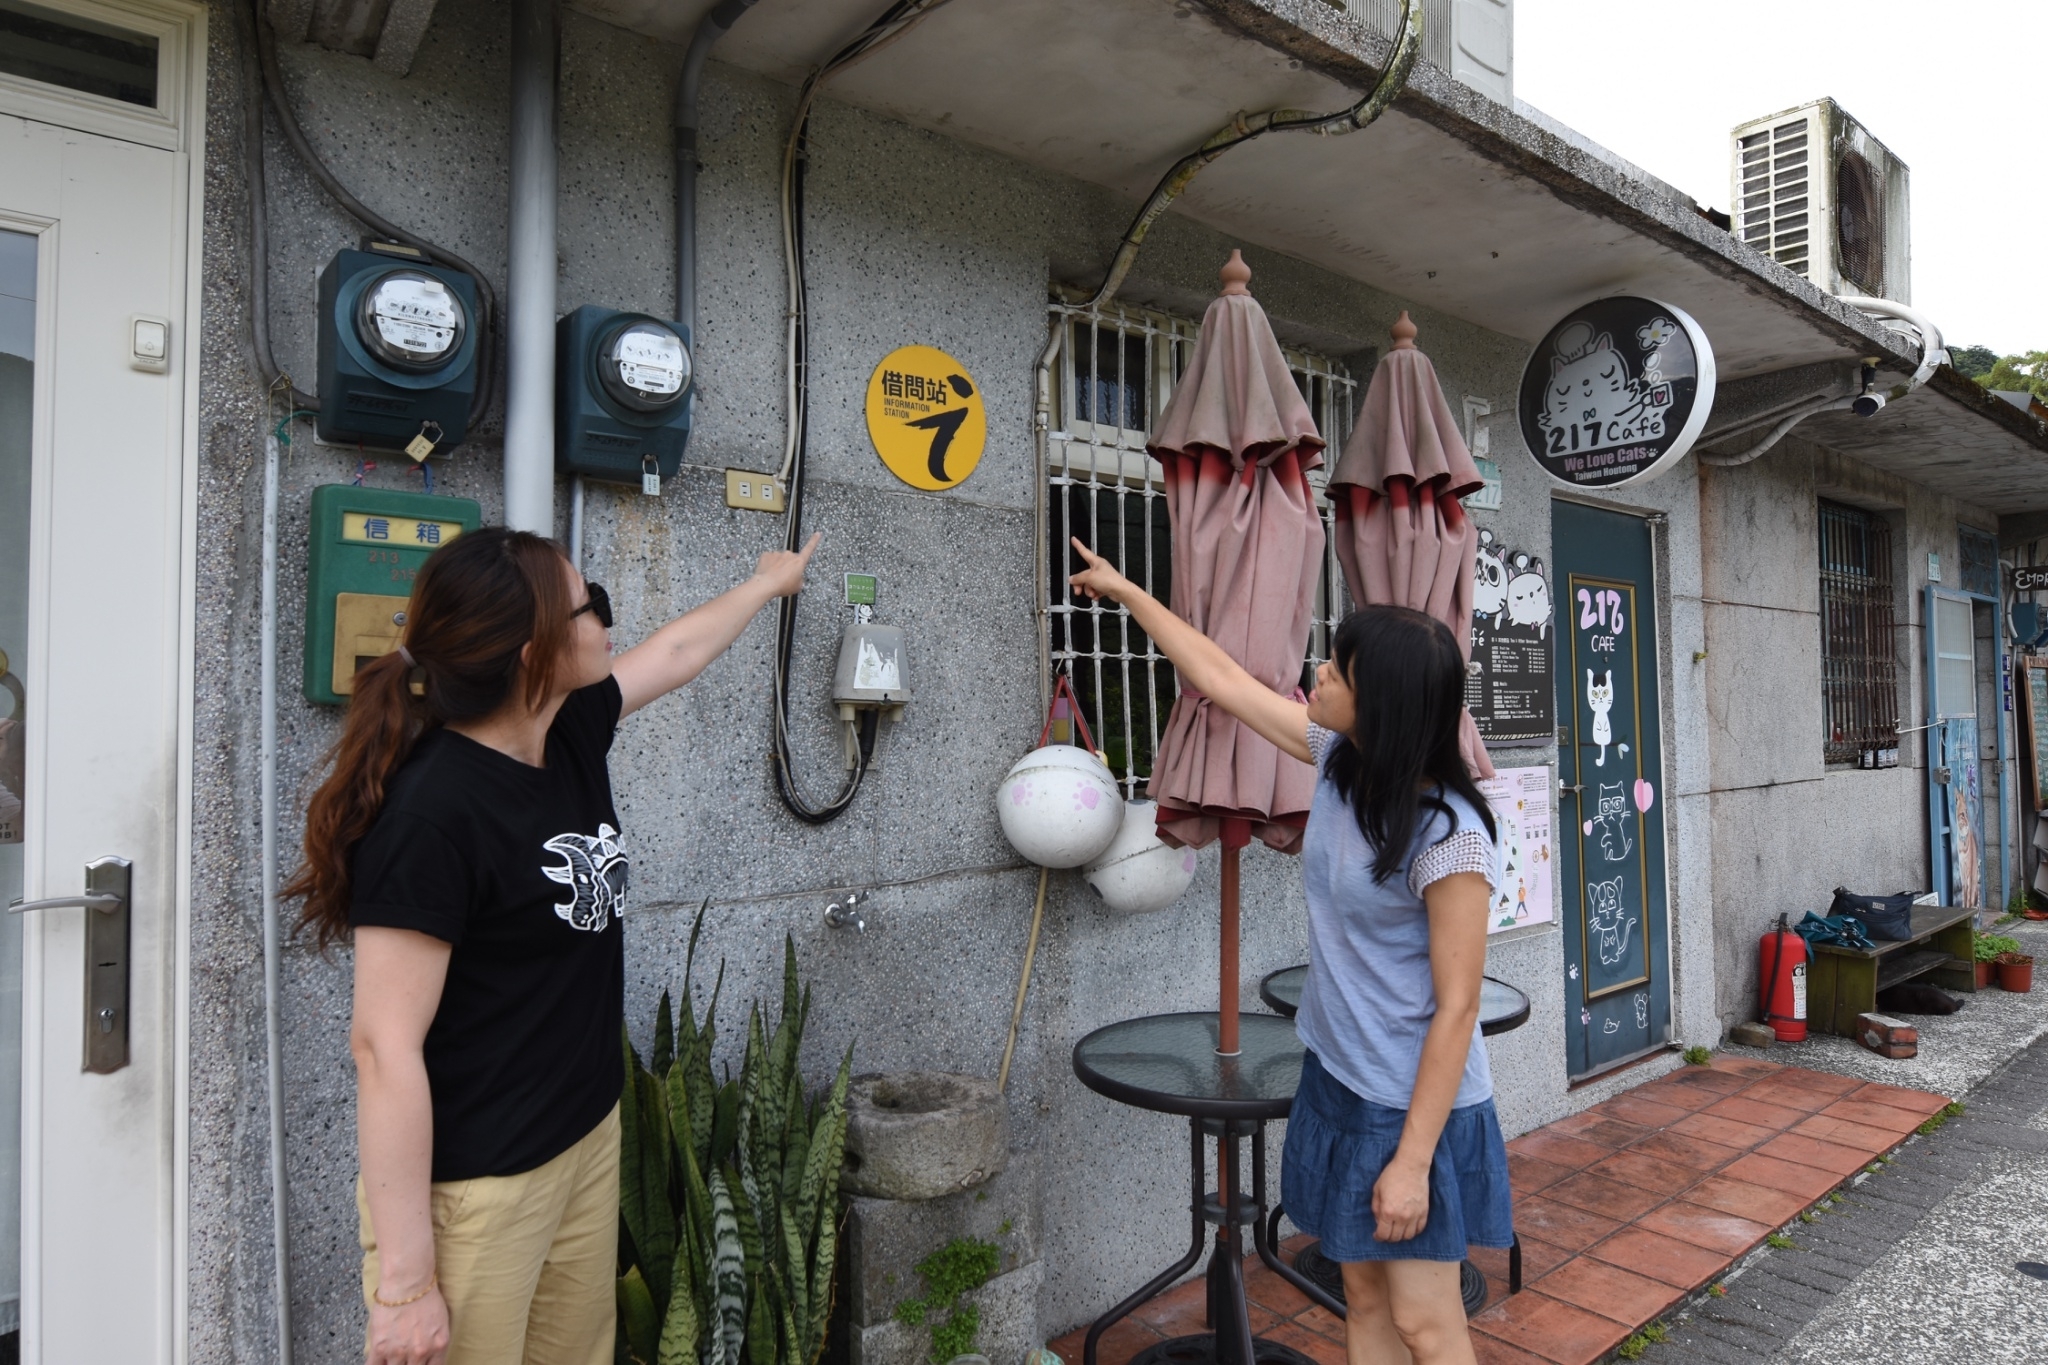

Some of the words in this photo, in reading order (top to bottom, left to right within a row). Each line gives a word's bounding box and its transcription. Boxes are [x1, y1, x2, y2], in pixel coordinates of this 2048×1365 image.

[882, 370, 947, 405] 借問站
[884, 398, 930, 412] INFORMATION
[884, 408, 910, 419] STATION
[1548, 422, 1602, 453] 217
[1607, 412, 1661, 441] Café
[1565, 457, 1585, 472] We
[1587, 452, 1615, 467] Love
[1618, 446, 1647, 462] Cats
[1574, 470, 1602, 481] Taiwan
[1603, 465, 1638, 478] Houtong
[1475, 483, 1499, 504] 217
[363, 517, 441, 544] 信箱
[368, 550, 400, 564] 213
[391, 568, 416, 581] 215
[1577, 588, 1624, 635] 217
[1471, 627, 1485, 647] fé
